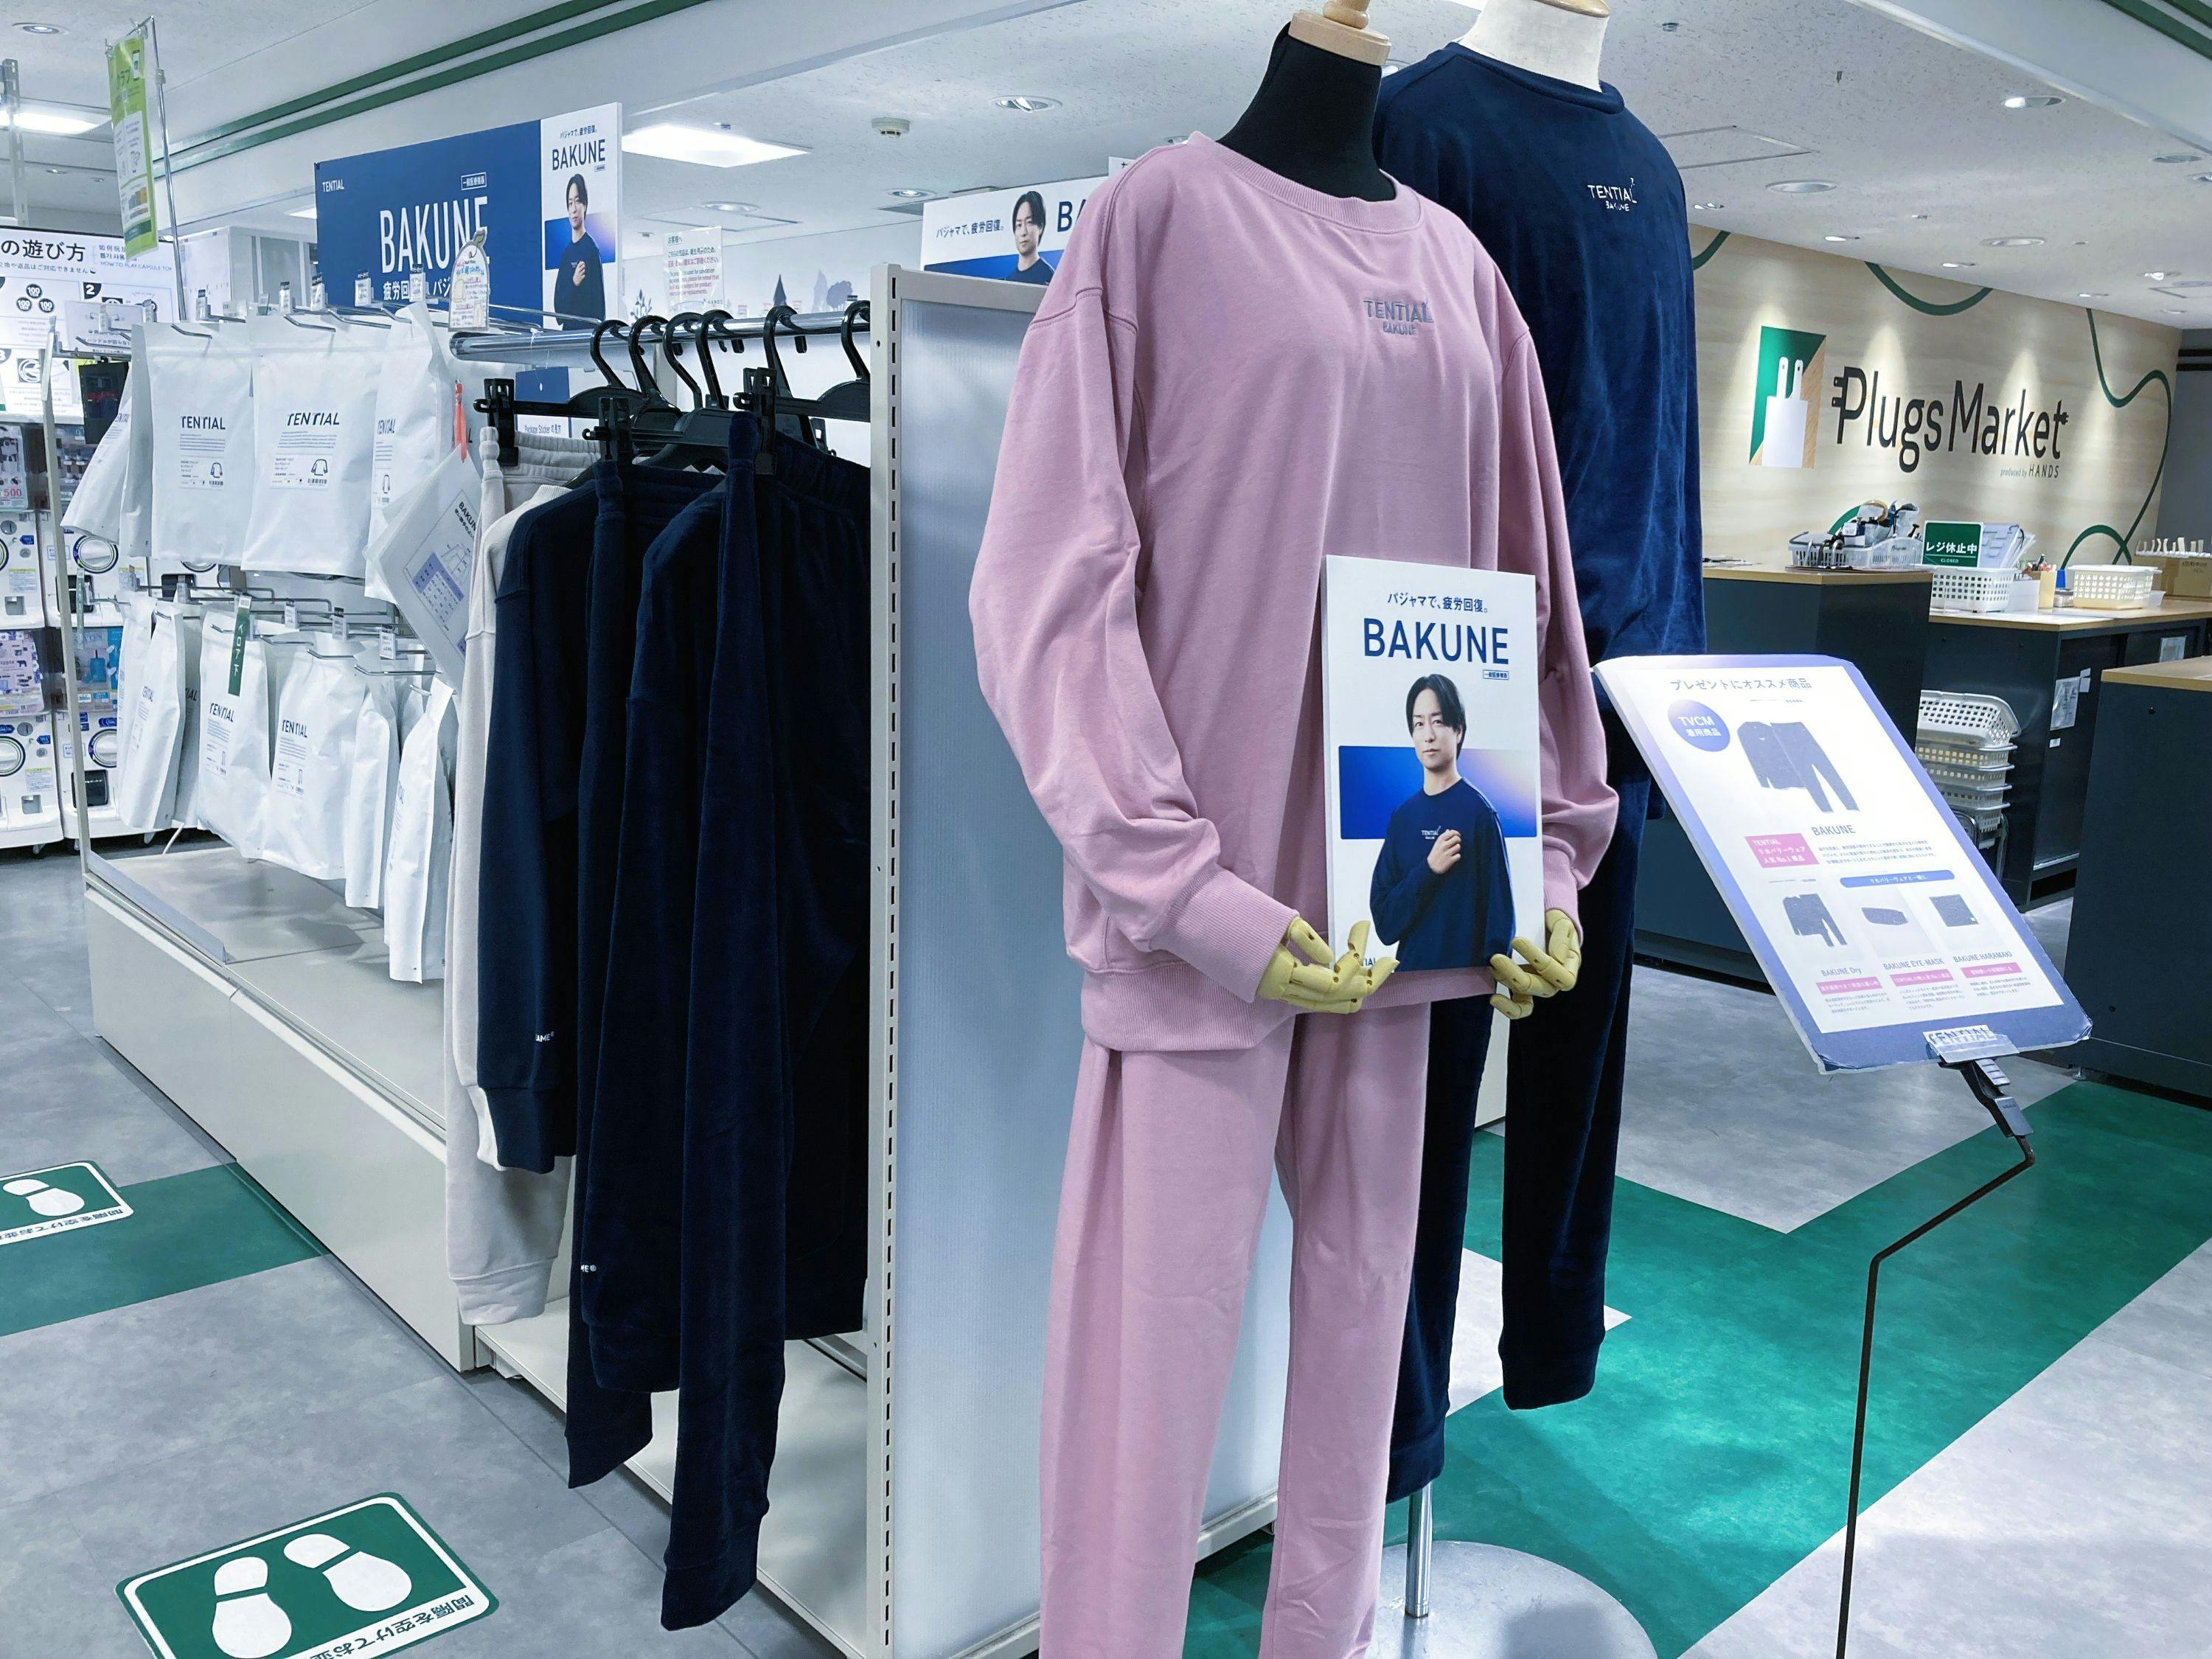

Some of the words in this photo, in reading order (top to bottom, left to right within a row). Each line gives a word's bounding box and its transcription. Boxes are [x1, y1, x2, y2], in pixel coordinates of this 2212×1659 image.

[552, 139, 605, 170] BAKUNE
[322, 179, 344, 192] TENTIAL
[1587, 184, 1637, 204] TENTIAL
[936, 219, 1004, 238] パジャマで、疲労回復。
[1, 239, 86, 262] の遊び方
[86, 285, 95, 295] 2
[1364, 299, 1434, 323] TENTIAL
[181, 416, 226, 430] TENTIAL
[287, 412, 340, 426] TENTIAL
[1832, 366, 1944, 473] Plugs
[1948, 380, 2069, 459] Market
[2028, 464, 2059, 479] HANDS
[4, 488, 22, 498] 500
[459, 501, 477, 532] BAKUN
[1925, 541, 1978, 554] レジ休止中
[1387, 592, 1488, 613] パジャマで、疲労回復。
[1363, 618, 1509, 665] BAKUNE
[1670, 678, 1812, 691] プレゼントにオススメ商品
[209, 703, 234, 723] TENTIAL
[282, 719, 307, 737] TENTIAL
[1677, 716, 1714, 726] TVCM
[1811, 824, 1856, 836] BAKUNE
[1758, 846, 1806, 855] リカバリーウェア
[1953, 954, 1980, 963] BAKUNE
[1980, 950, 2013, 960] HARAMAKI
[1882, 961, 1910, 970] BAKUNE
[1911, 958, 1944, 967] EYE-MASK
[1821, 967, 1849, 976] BAKUNE
[1849, 967, 1862, 975] Dry
